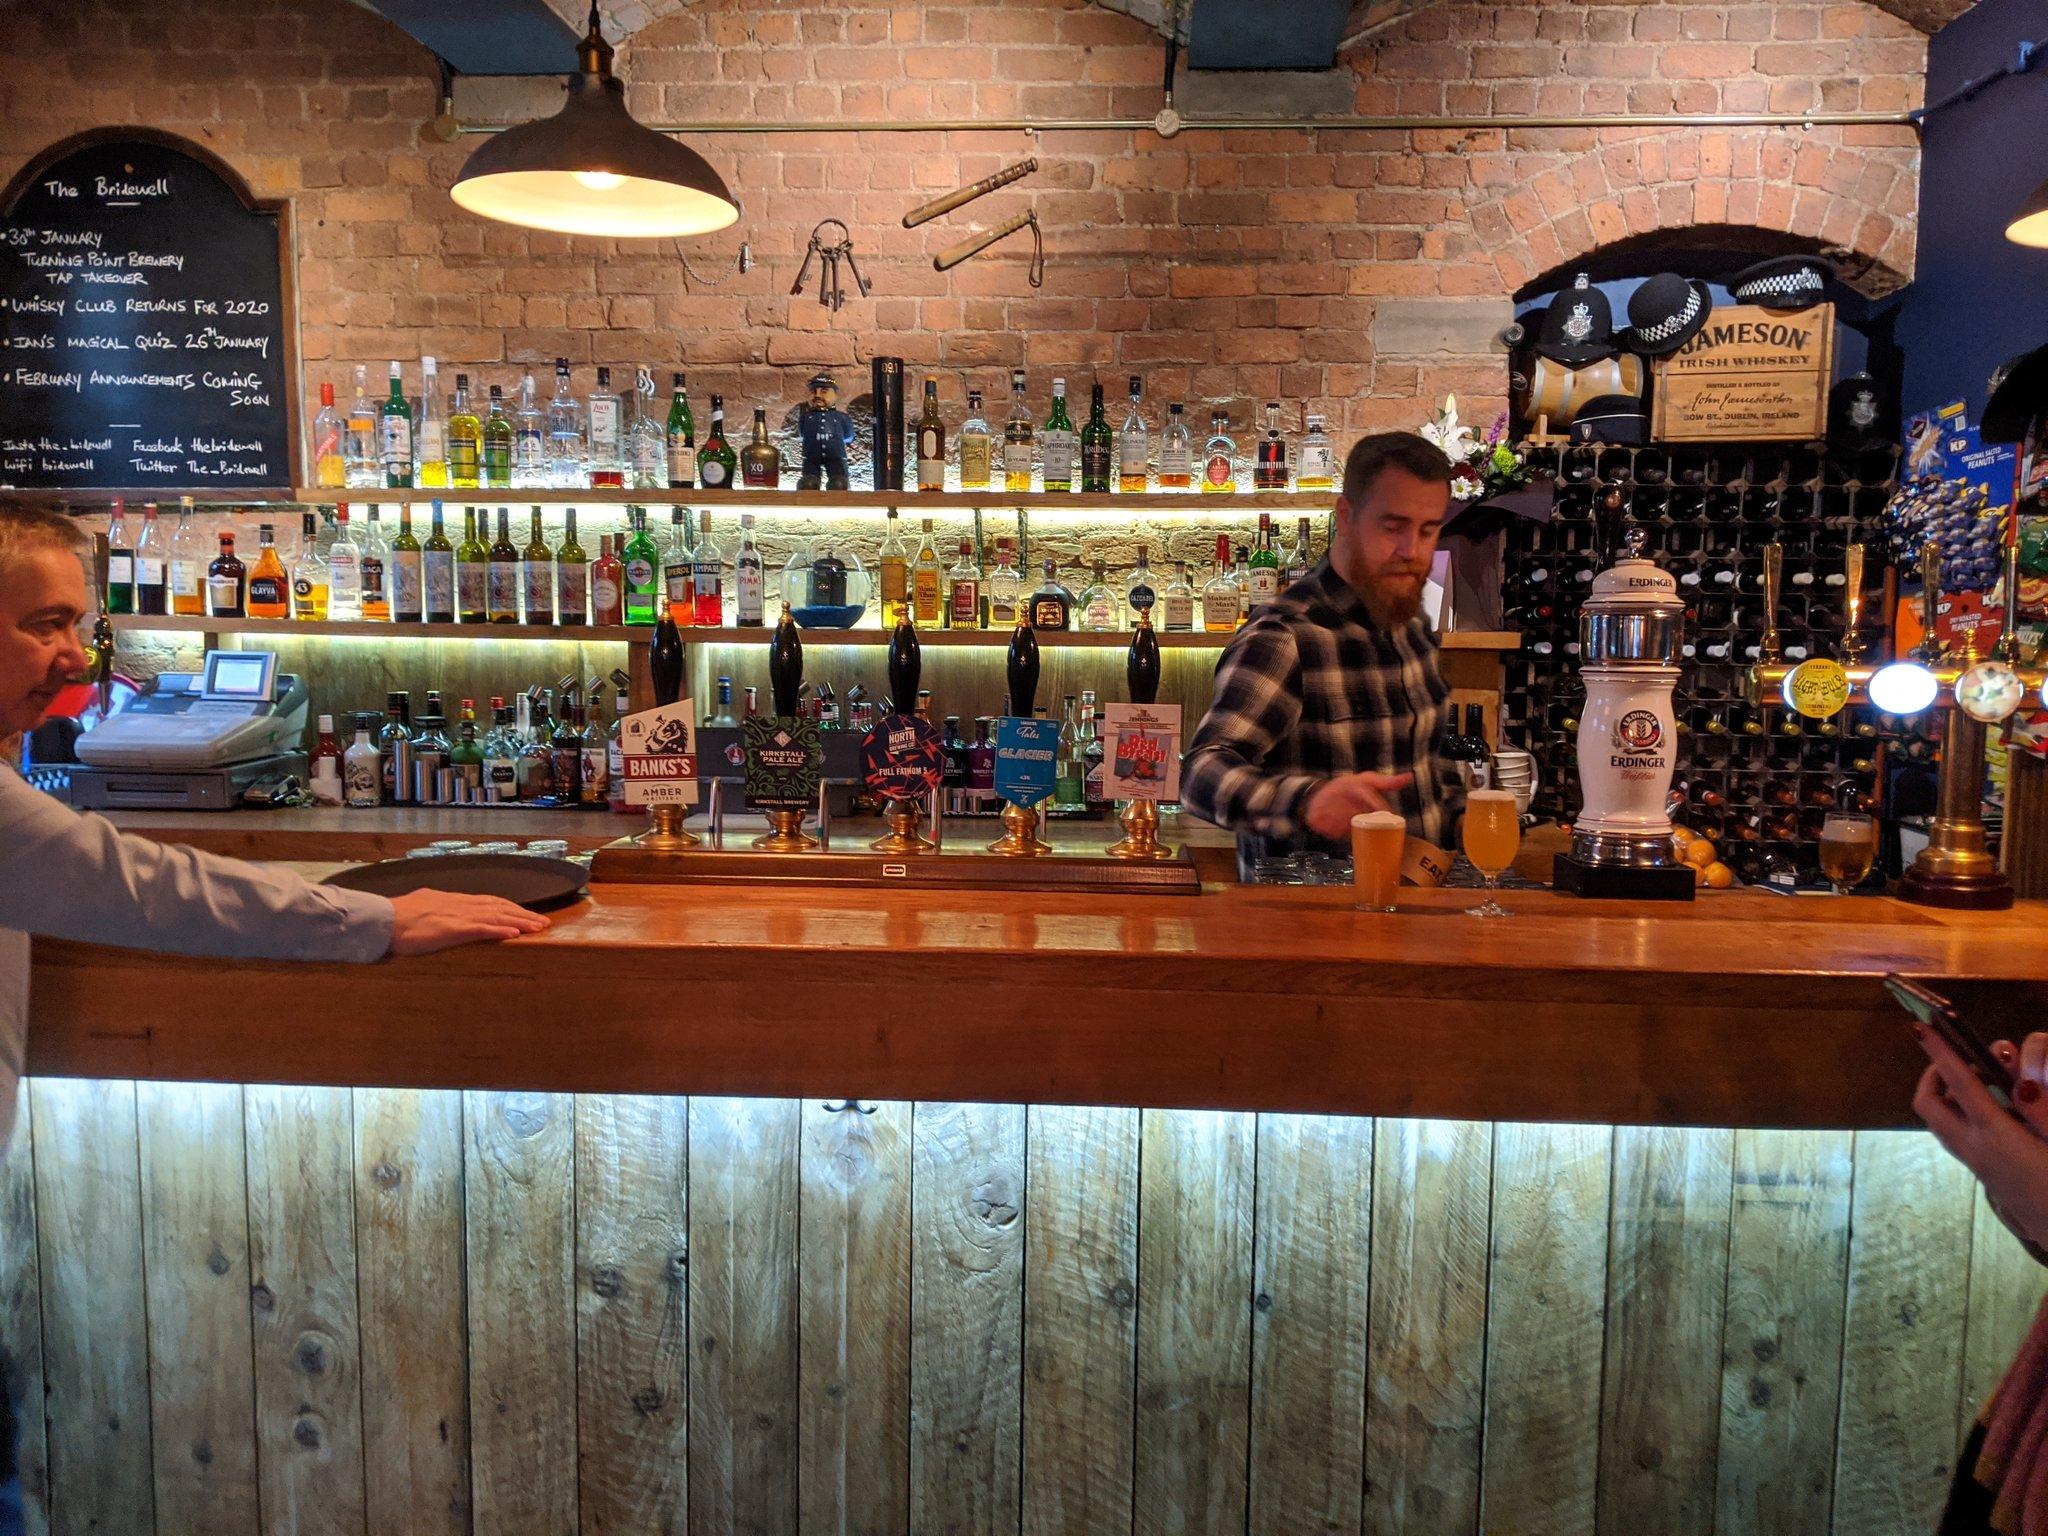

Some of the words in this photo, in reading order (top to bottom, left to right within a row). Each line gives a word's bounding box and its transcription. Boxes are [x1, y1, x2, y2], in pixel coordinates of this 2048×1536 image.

[45, 180, 79, 197] The
[95, 176, 169, 196] Bridewell
[41, 230, 103, 248] JANUARY
[20, 252, 83, 267] TURNING
[88, 252, 125, 267] POINT
[128, 252, 184, 271] BREWERY
[45, 273, 74, 284] TAP
[81, 273, 149, 286] TAKEOVER
[12, 295, 65, 316] WHISKY
[75, 299, 118, 313] CLUB
[126, 299, 186, 313] RETURNS
[224, 300, 269, 315] 2020
[13, 334, 56, 349] IAN'S
[67, 335, 129, 350] MAGICAL
[135, 331, 178, 352] QUIZ
[214, 336, 269, 359] JANUARY
[1680, 322, 1812, 355] JAMESON
[1679, 357, 1728, 368] IRISH
[1732, 355, 1810, 366] WHISKEY
[15, 368, 82, 393] FEBRUARY
[89, 369, 195, 390] ANNOUNCEMENTS
[202, 371, 263, 390] COMING
[229, 390, 270, 407] SOON
[1691, 392, 1719, 411] John
[133, 436, 184, 453] Facebook
[1949, 440, 1967, 453] KP
[1961, 451, 1984, 463] ORIGINAL
[1967, 456, 1995, 469] PEANUTS
[129, 458, 177, 473] Twitter
[750, 463, 763, 472] XO
[295, 583, 308, 593] 43
[1629, 577, 1673, 588] ERDINGER
[251, 586, 276, 595] GLAYVA
[1937, 602, 1952, 614] KP
[1951, 621, 1979, 632] PEANUTS
[1622, 712, 1658, 727] ERDINGER
[888, 730, 915, 744] NORTH
[760, 750, 806, 758] KIRKSTALL
[998, 747, 1054, 761] GLACIER
[630, 757, 691, 776] BANKS'S
[1610, 755, 1666, 768] ERDINGER
[879, 768, 895, 776] FULL
[896, 766, 922, 776] FATHOM
[642, 787, 682, 797] AMBER
